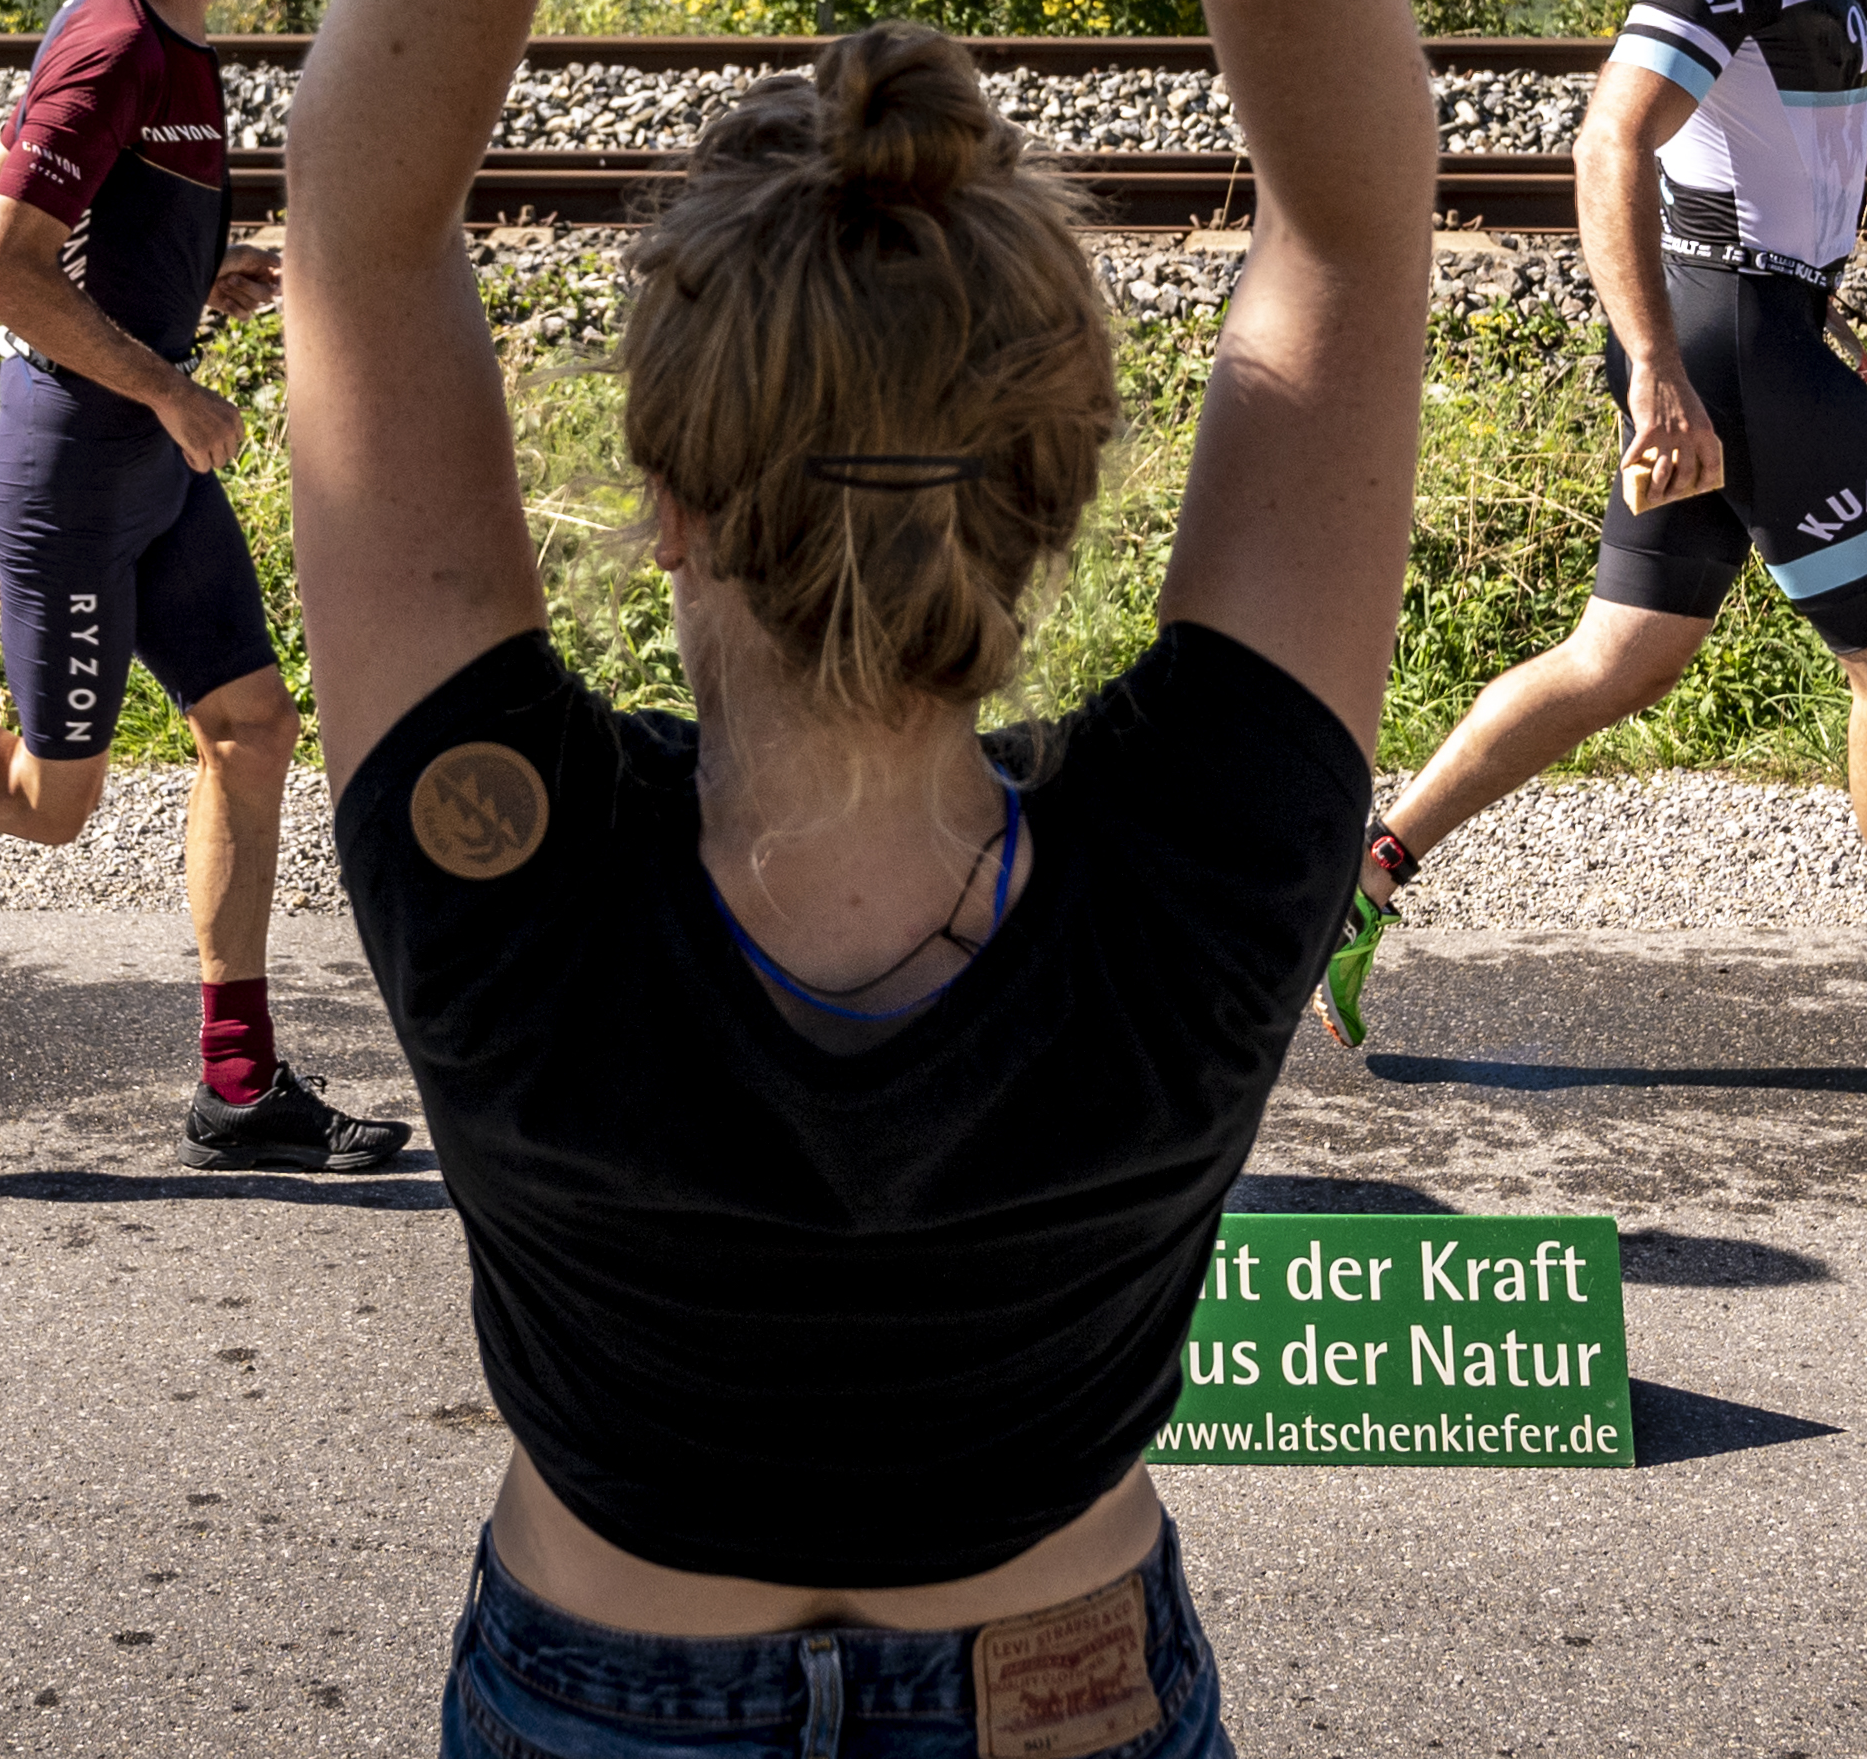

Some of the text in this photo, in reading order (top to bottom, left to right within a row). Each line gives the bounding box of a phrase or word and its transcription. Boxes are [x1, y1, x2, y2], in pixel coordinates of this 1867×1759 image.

[141, 124, 222, 142] CANYON
[21, 140, 82, 181] CANYON
[65, 593, 100, 741] RYZON
[1199, 1239, 1588, 1303] it der Kraft
[1188, 1324, 1602, 1388] us der Natur
[1154, 1412, 1619, 1455] www.latschenkiefer.de
